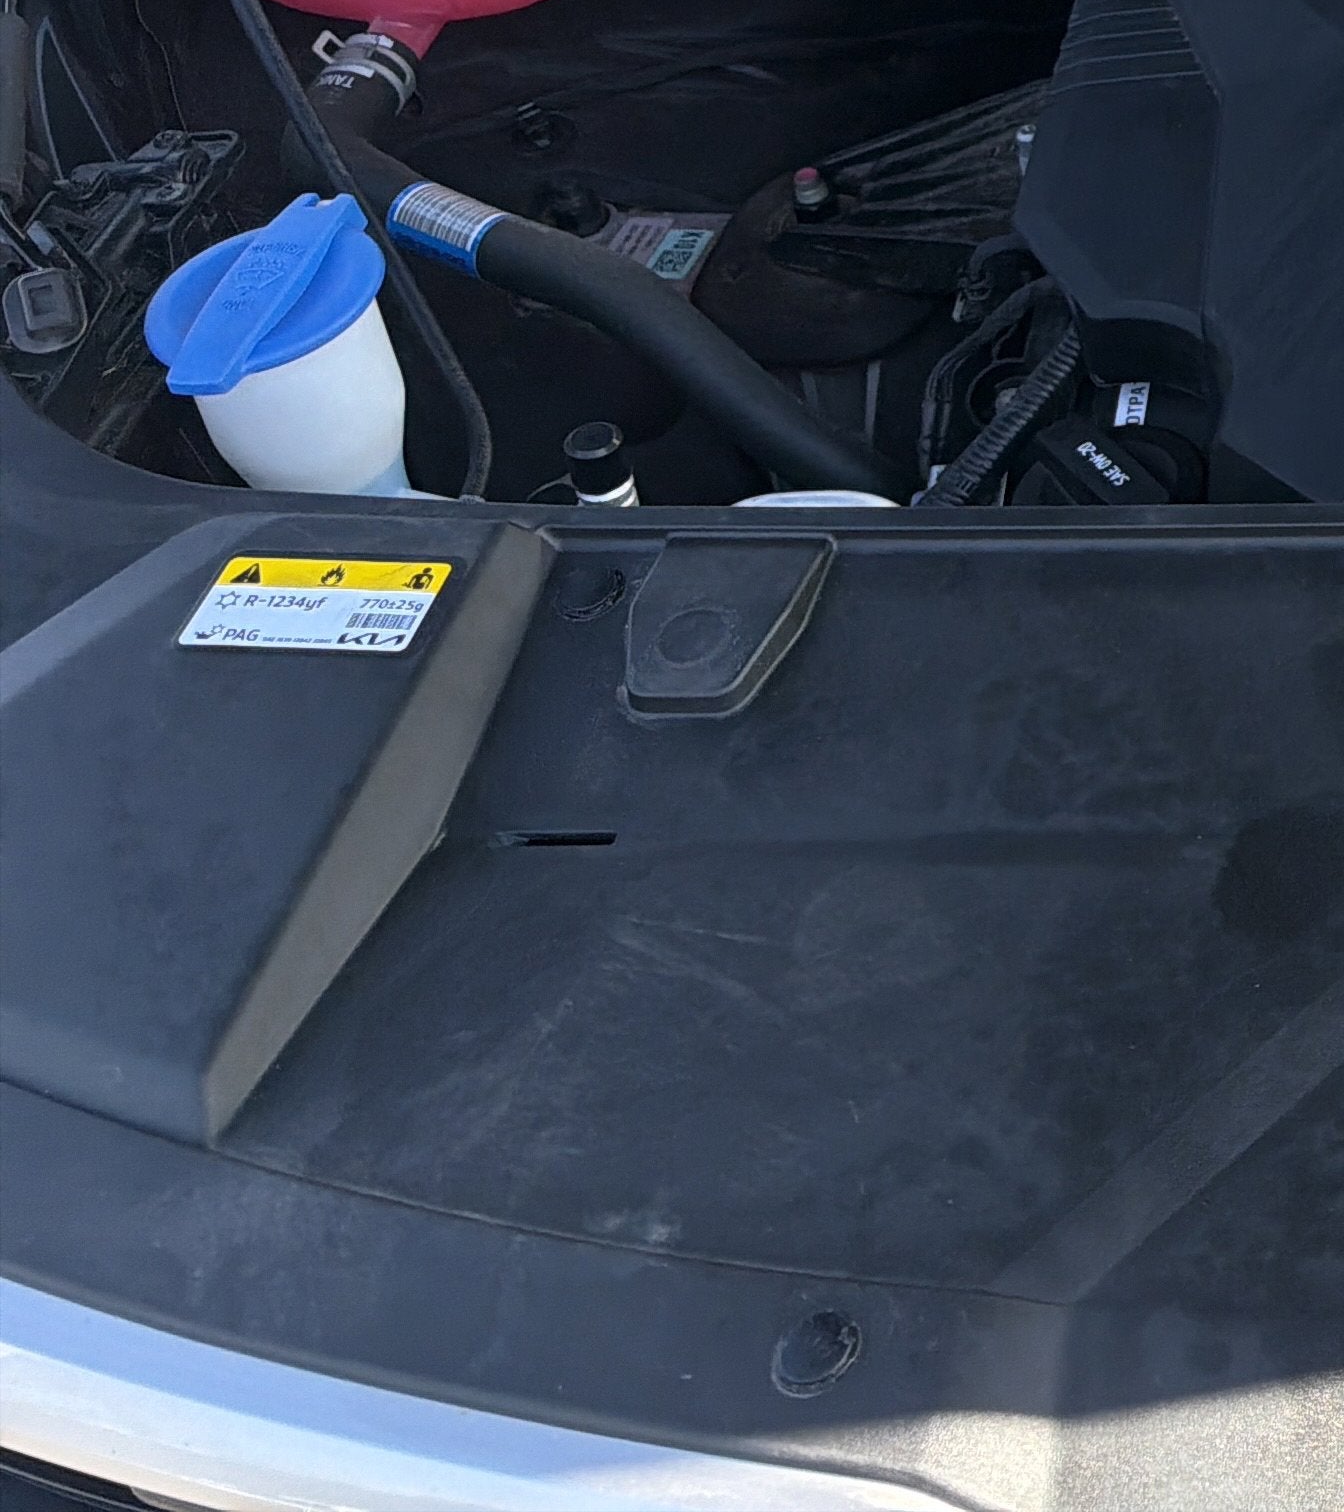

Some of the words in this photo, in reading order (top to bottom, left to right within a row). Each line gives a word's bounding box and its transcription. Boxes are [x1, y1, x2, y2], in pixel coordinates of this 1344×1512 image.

[1103, 464, 1131, 486] SAE
[243, 593, 328, 611] R-1234yf
[360, 597, 425, 613] 770±25g
[222, 627, 261, 642] PAG
